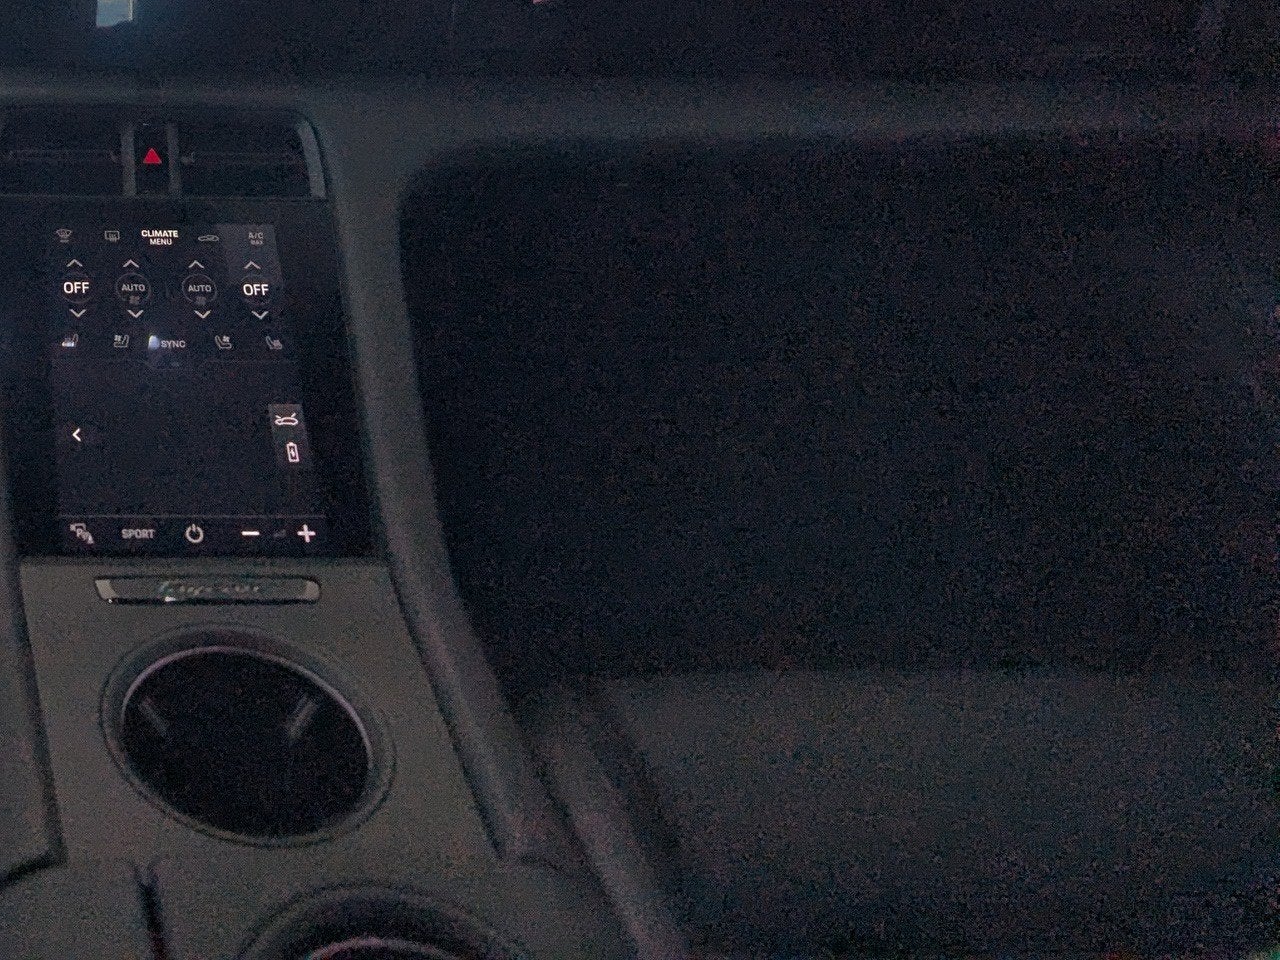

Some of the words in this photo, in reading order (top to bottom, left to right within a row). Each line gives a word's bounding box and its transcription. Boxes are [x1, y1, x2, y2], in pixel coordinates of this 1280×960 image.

[141, 229, 178, 238] CLIMATE
[248, 232, 263, 240] A/C
[63, 281, 90, 294] OFF
[121, 283, 145, 292] AUTO
[188, 284, 211, 292] AUTO
[243, 284, 268, 296] OFF
[160, 340, 186, 348] SYNC
[121, 528, 155, 539] SPORT
